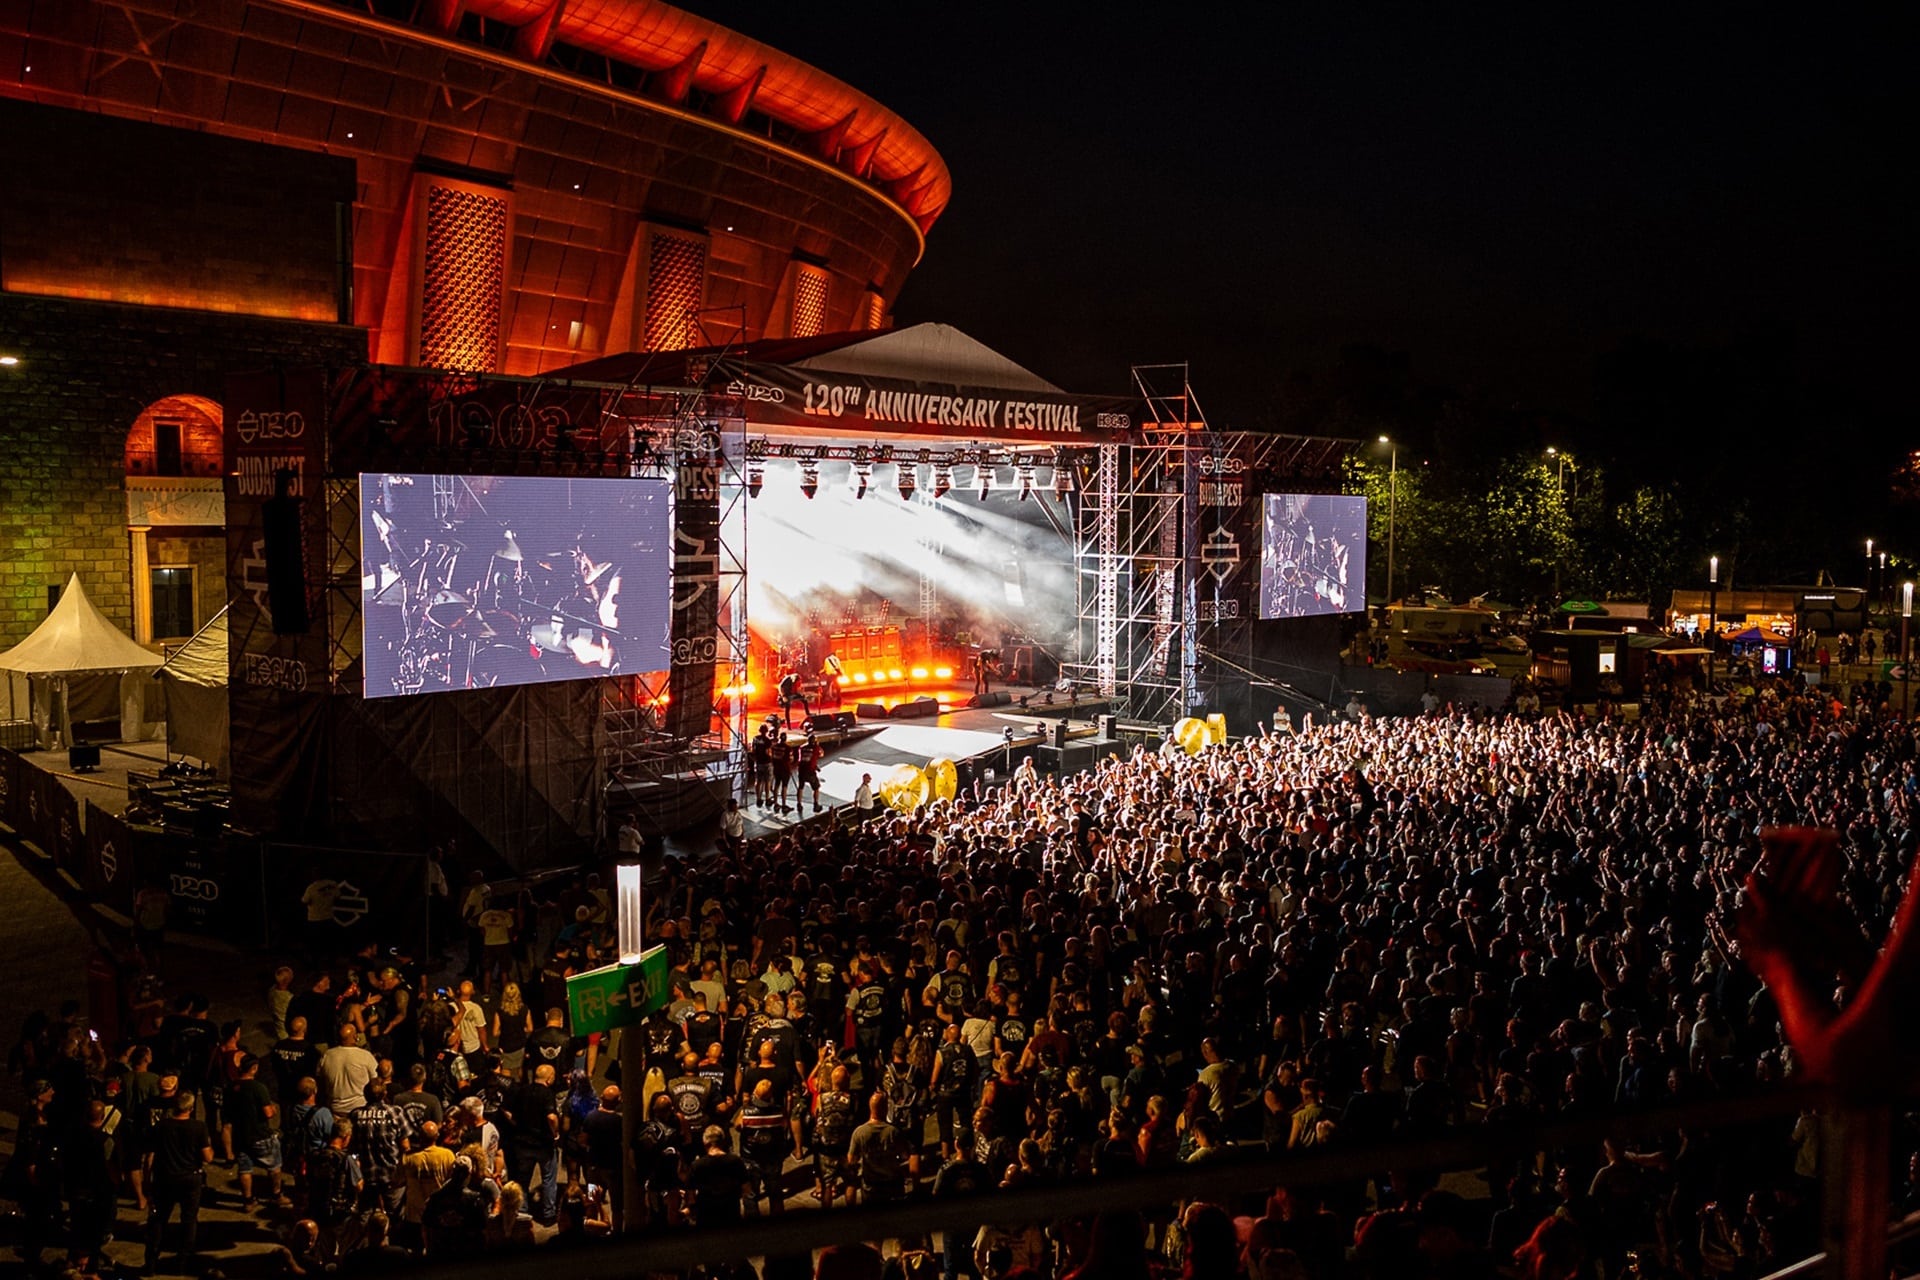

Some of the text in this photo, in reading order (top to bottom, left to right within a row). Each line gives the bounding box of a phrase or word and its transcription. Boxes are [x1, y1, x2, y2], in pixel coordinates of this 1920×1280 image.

[747, 384, 785, 403] 120
[803, 382, 1082, 432] 120TH ANNIVERSARY FESTIVAL
[259, 411, 305, 438] 120
[1214, 457, 1244, 474] 120
[1200, 483, 1244, 507] BUDAPEST
[169, 873, 219, 901] 120
[628, 968, 663, 1009] EXIT
